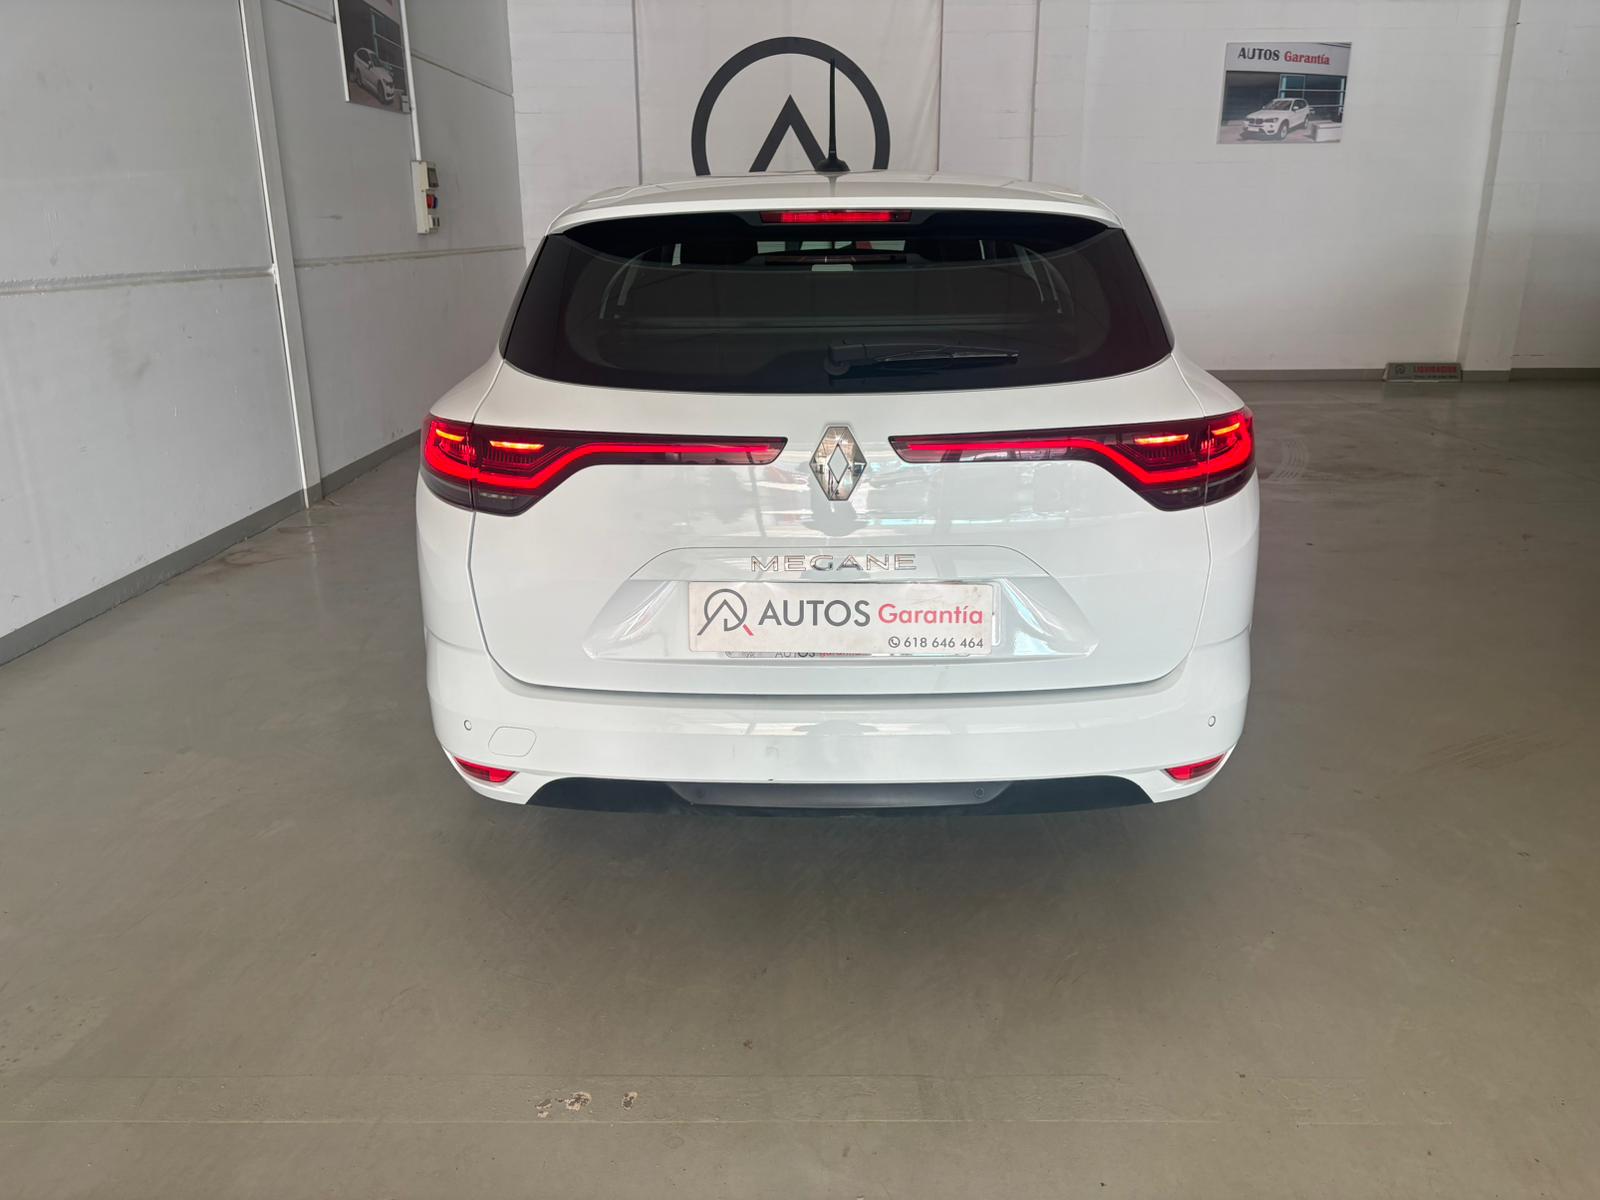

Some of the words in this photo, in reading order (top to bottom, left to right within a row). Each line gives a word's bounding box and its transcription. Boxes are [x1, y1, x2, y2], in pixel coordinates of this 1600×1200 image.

[1238, 47, 1280, 61] AUTOS
[1284, 51, 1330, 65] Garantía
[751, 555, 916, 571] MEGANE
[758, 600, 870, 627] AUTOS
[878, 603, 983, 624] Garantía
[904, 637, 928, 648] 618
[931, 637, 956, 649] 646
[960, 638, 984, 649] 464
